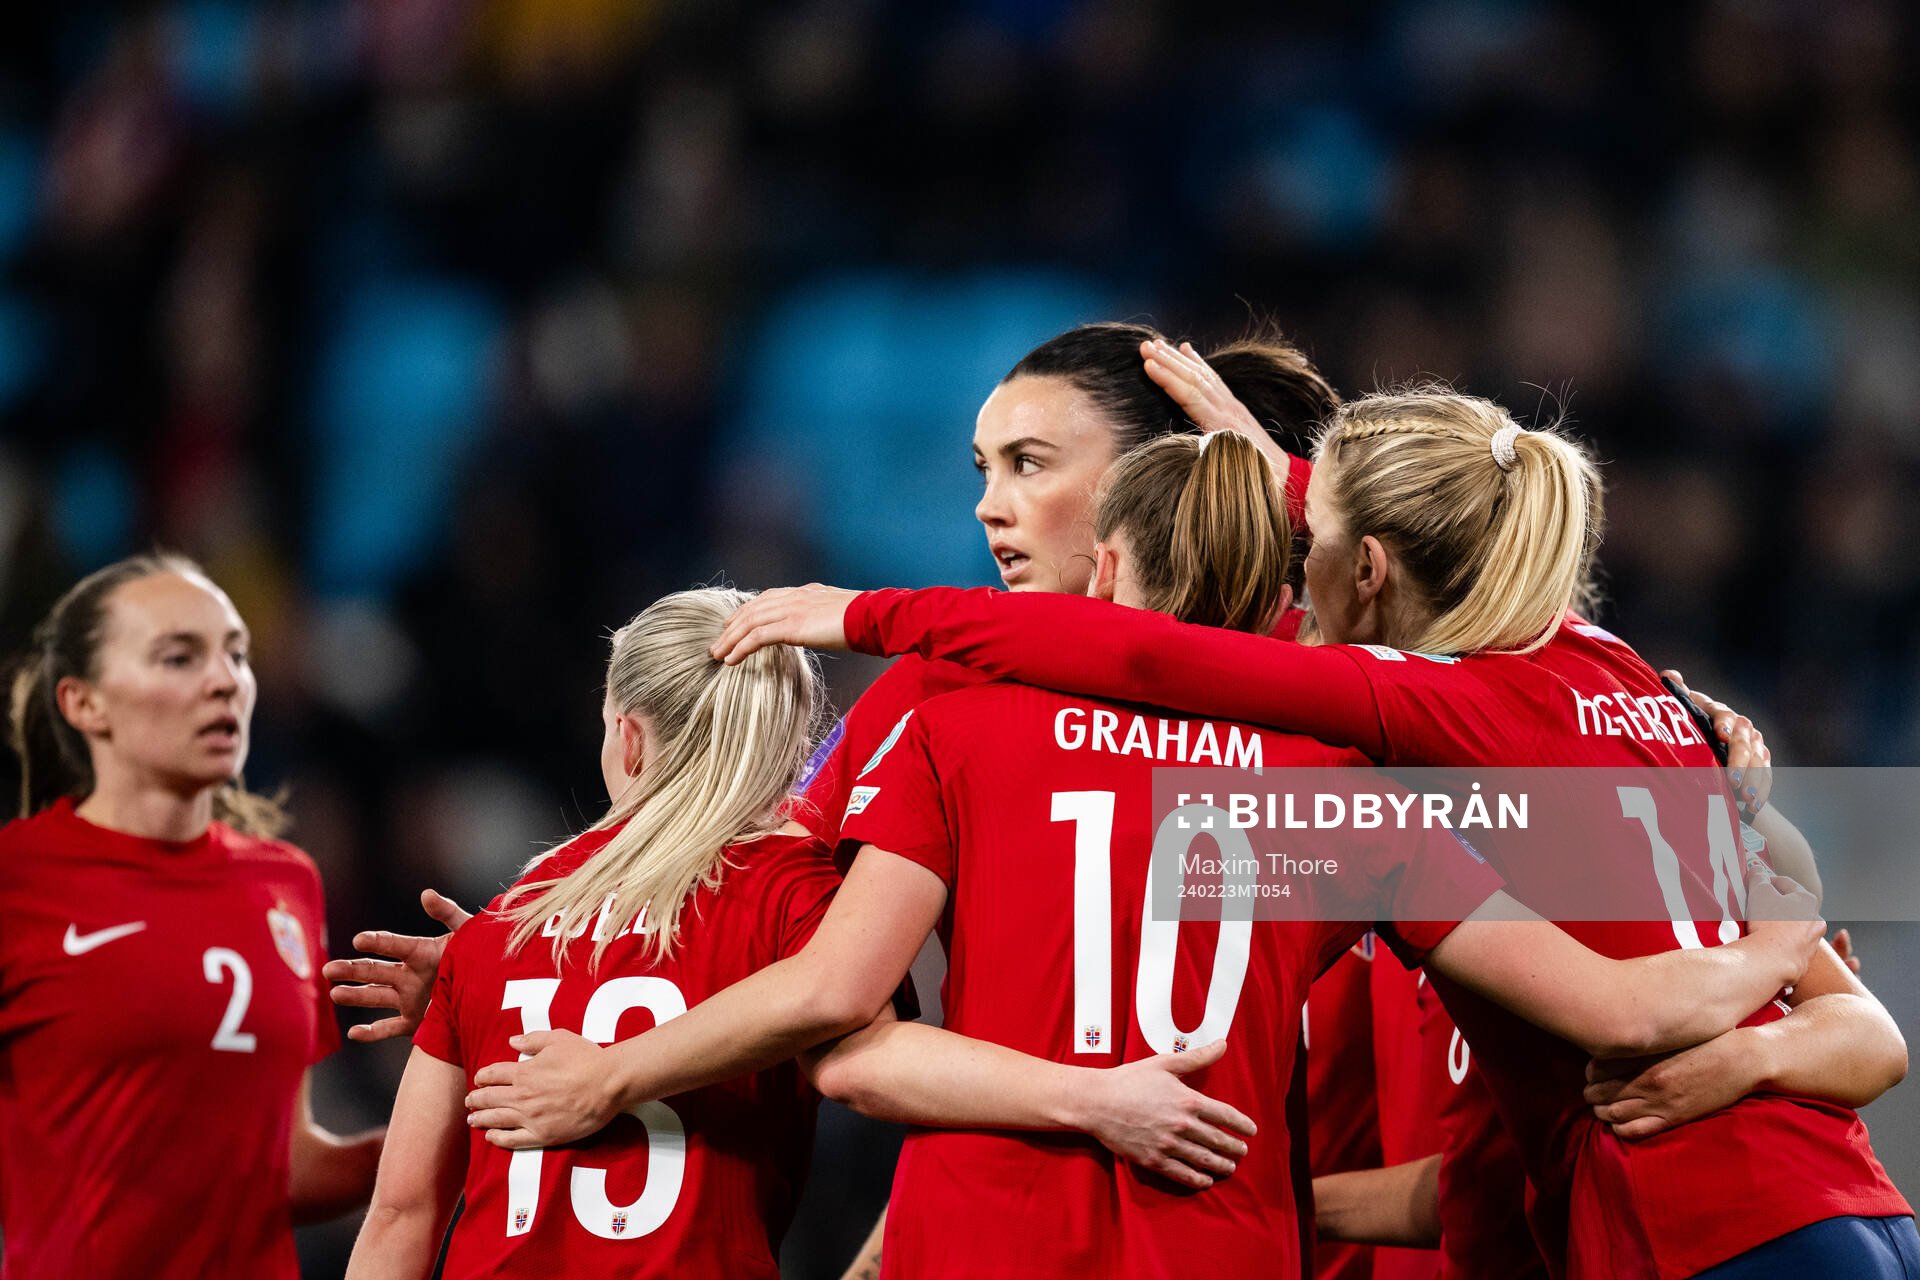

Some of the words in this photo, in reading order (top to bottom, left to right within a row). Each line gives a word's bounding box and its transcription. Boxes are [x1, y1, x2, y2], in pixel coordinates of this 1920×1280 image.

[1054, 708, 1264, 776] GRAHAM
[202, 946, 257, 1053] 2
[1051, 791, 1257, 1056] 10
[501, 976, 688, 1240] 13
